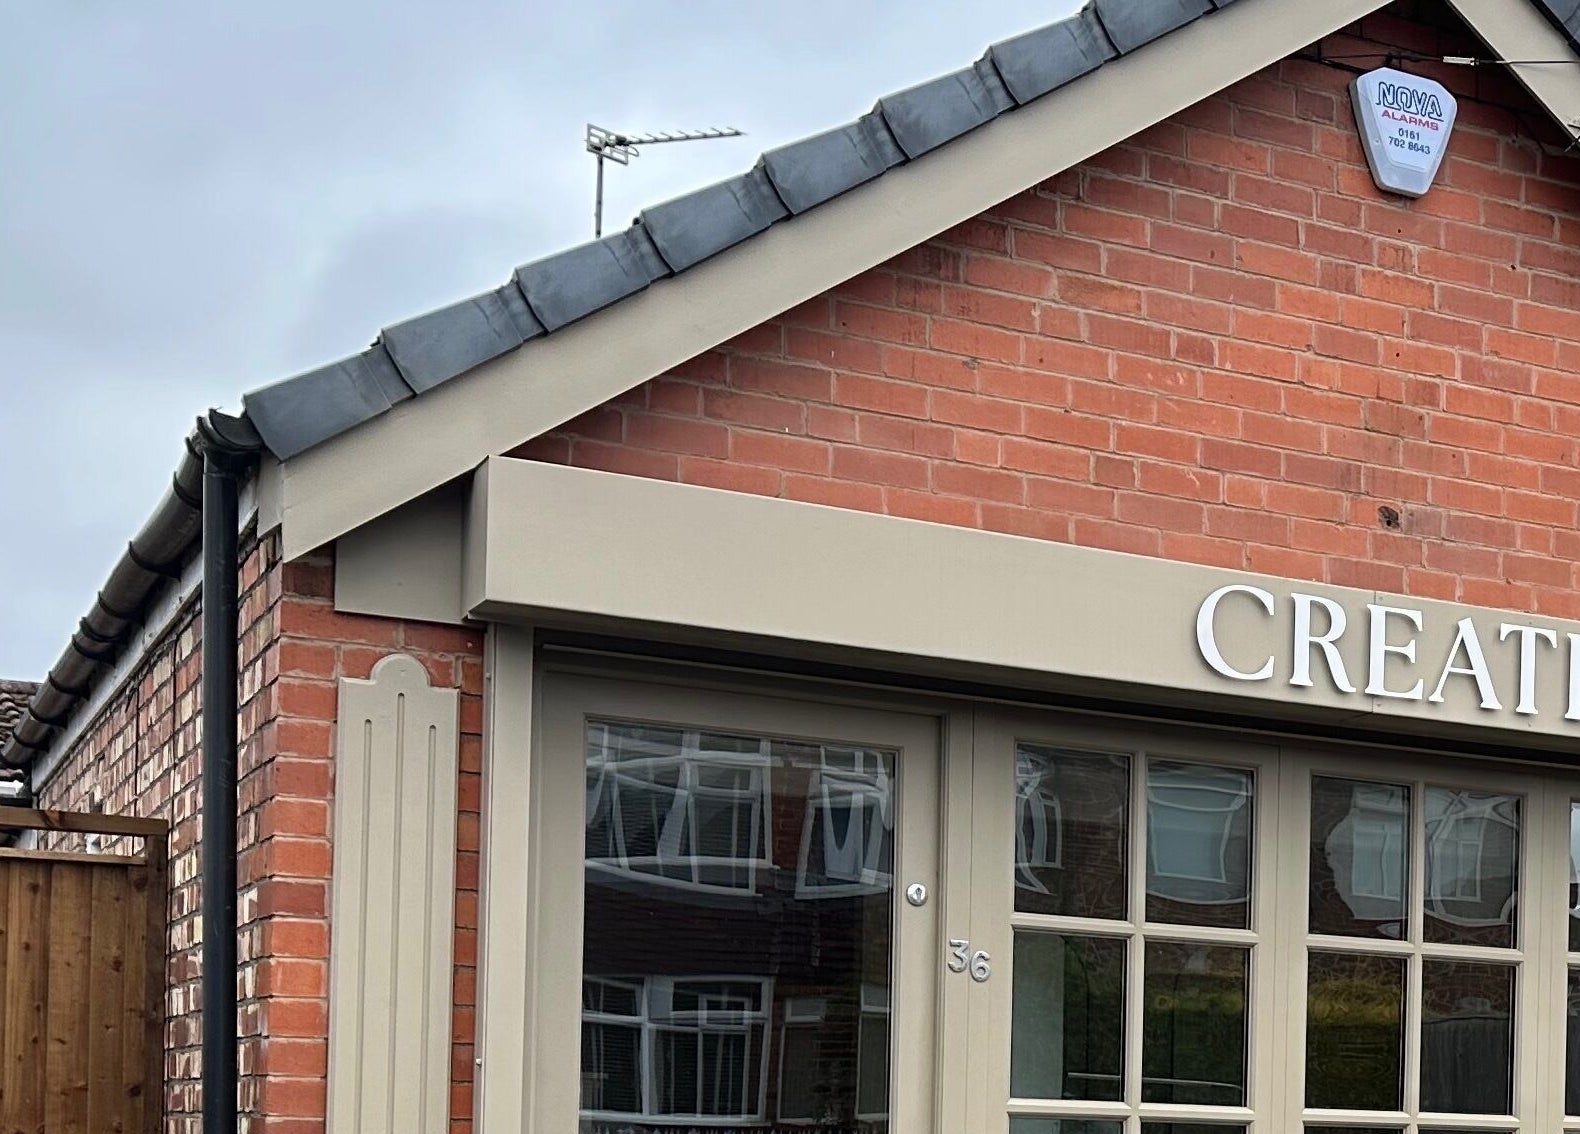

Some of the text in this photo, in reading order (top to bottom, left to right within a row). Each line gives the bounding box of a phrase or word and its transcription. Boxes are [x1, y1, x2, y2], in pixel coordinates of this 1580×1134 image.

[1376, 81, 1445, 122] NOVA
[1381, 109, 1439, 131] ALARMS
[1388, 135, 1406, 149] 702
[1398, 127, 1420, 141] 0161
[947, 938, 992, 983] 36
